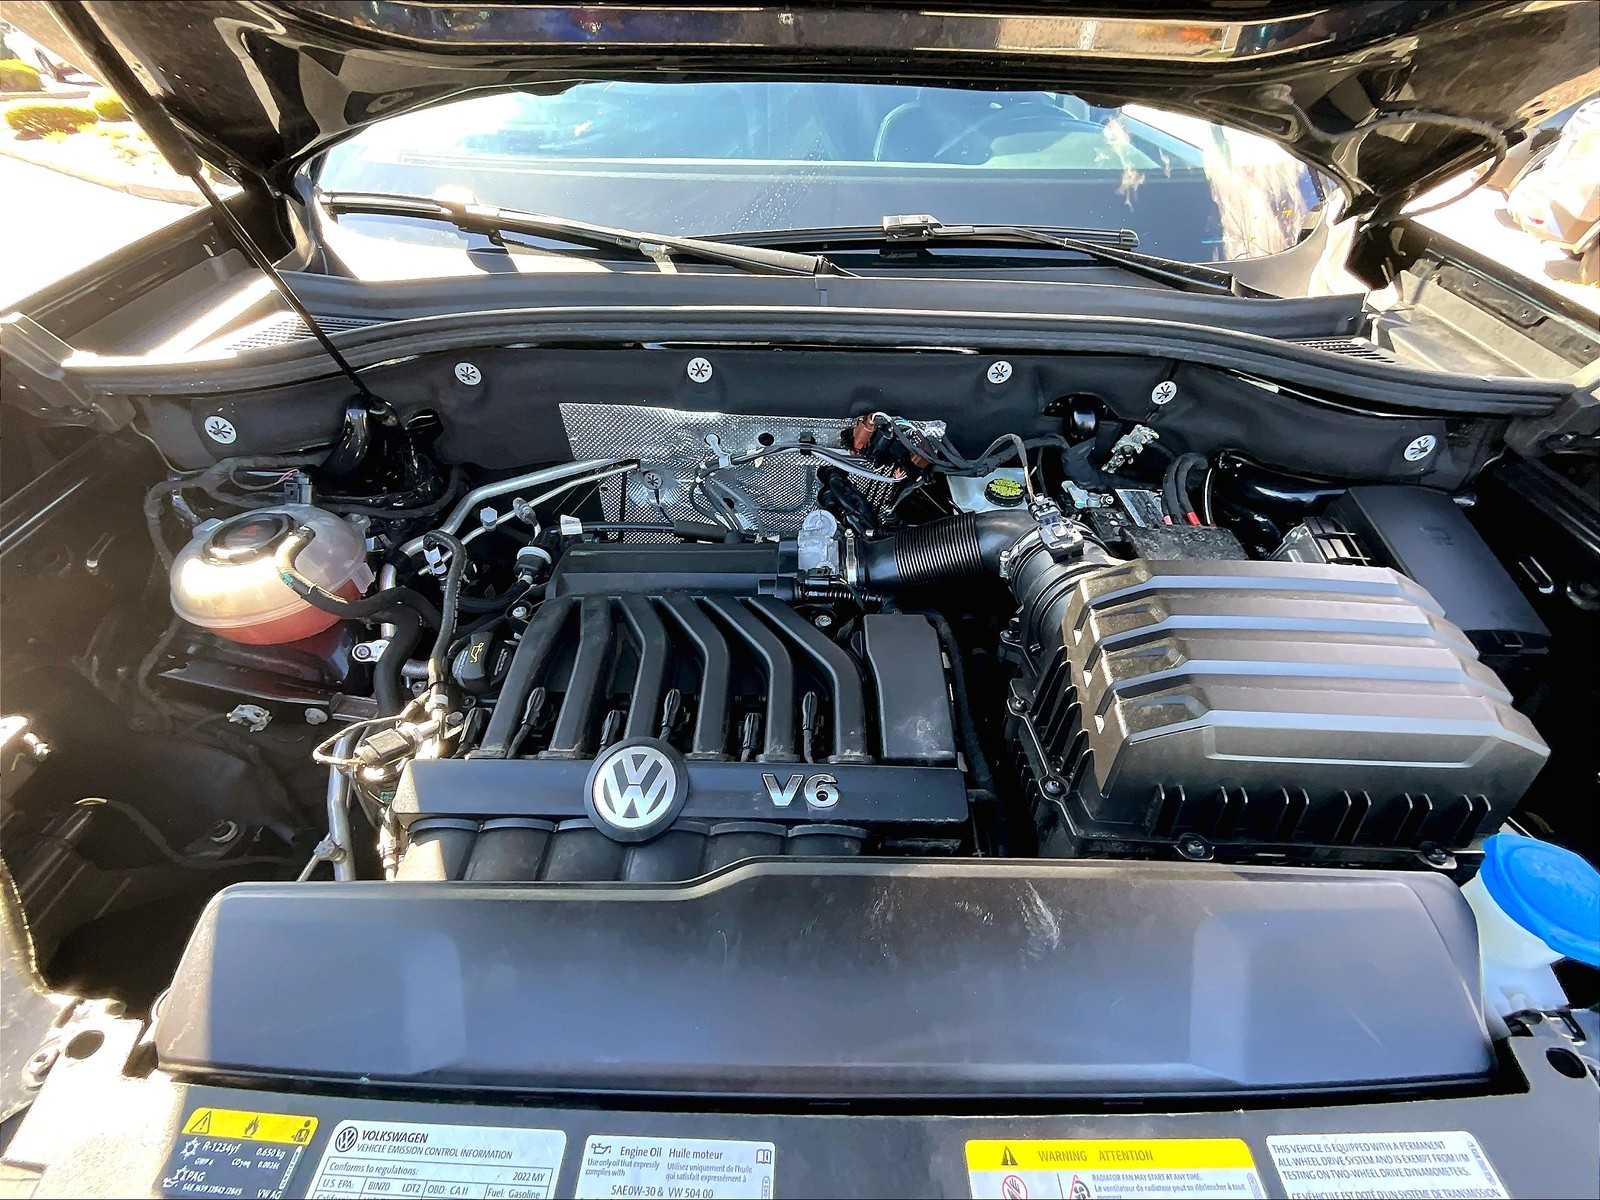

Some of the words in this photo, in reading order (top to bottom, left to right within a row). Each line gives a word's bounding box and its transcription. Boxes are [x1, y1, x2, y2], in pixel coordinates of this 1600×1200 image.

[761, 773, 840, 808] V6
[362, 1130, 429, 1144] VOLKSWAGEN
[202, 1140, 242, 1156] R-1234yf
[256, 1147, 276, 1157] 0.650
[275, 1150, 287, 1160] kg
[356, 1143, 386, 1154] VEHICLE
[387, 1144, 424, 1155] EMISSION
[424, 1146, 458, 1158] CONTROL
[460, 1148, 513, 1160] INFORMATION
[620, 1146, 649, 1159] Engine
[649, 1147, 663, 1157] Oil
[668, 1147, 691, 1159] Huile
[692, 1149, 723, 1160] moteur
[1271, 1144, 1291, 1154] THIS
[1290, 1143, 1323, 1154] VEHICLE
[1323, 1143, 1332, 1153] IS
[1331, 1142, 1370, 1154] EQUIPPED
[1370, 1142, 1393, 1152] WITH
[1392, 1142, 1400, 1151] A
[1399, 1140, 1446, 1151] PERMANENT
[1038, 1150, 1088, 1162] WARNING
[1098, 1149, 1154, 1161] ATTENTION
[1278, 1157, 1321, 1167] ALL-WHEEL
[1320, 1156, 1345, 1166] DRIVE
[1344, 1155, 1374, 1166] SYSTEM
[1375, 1154, 1393, 1164] AND
[1393, 1154, 1402, 1164] IS
[1401, 1153, 1432, 1163] EXEMPT
[1431, 1153, 1455, 1163] FROM
[329, 1161, 365, 1173] Conforms
[365, 1164, 374, 1173] to
[587, 1158, 599, 1166] Use
[599, 1158, 612, 1168] only
[612, 1159, 620, 1167] oil
[620, 1159, 633, 1168] that
[633, 1160, 660, 1171] expressly
[689, 1163, 725, 1174] uniquement
[726, 1164, 734, 1172] de
[186, 1170, 206, 1183] PAG
[512, 1171, 531, 1182] 2022
[531, 1172, 546, 1182] MY
[611, 1168, 626, 1177] with
[665, 1172, 676, 1182] qui
[676, 1172, 700, 1181] satisfait
[1147, 1173, 1165, 1181] START
[1282, 1170, 1316, 1180] TESTING
[1316, 1169, 1331, 1180] ON
[1330, 1168, 1380, 1179] TWO-WHEEL
[1379, 1167, 1405, 1178] DRIVE
[257, 1189, 272, 1199] VW
[271, 1190, 283, 1199] AG
[367, 1181, 391, 1192] BIN70
[401, 1183, 421, 1193] LDT2
[449, 1185, 461, 1196] CA
[487, 1188, 506, 1198] Fuel:
[508, 1189, 541, 1199] Gasoline
[657, 1186, 664, 1197] &
[668, 1186, 684, 1199] VW
[684, 1187, 702, 1199] 504
[702, 1188, 714, 1199] 00
